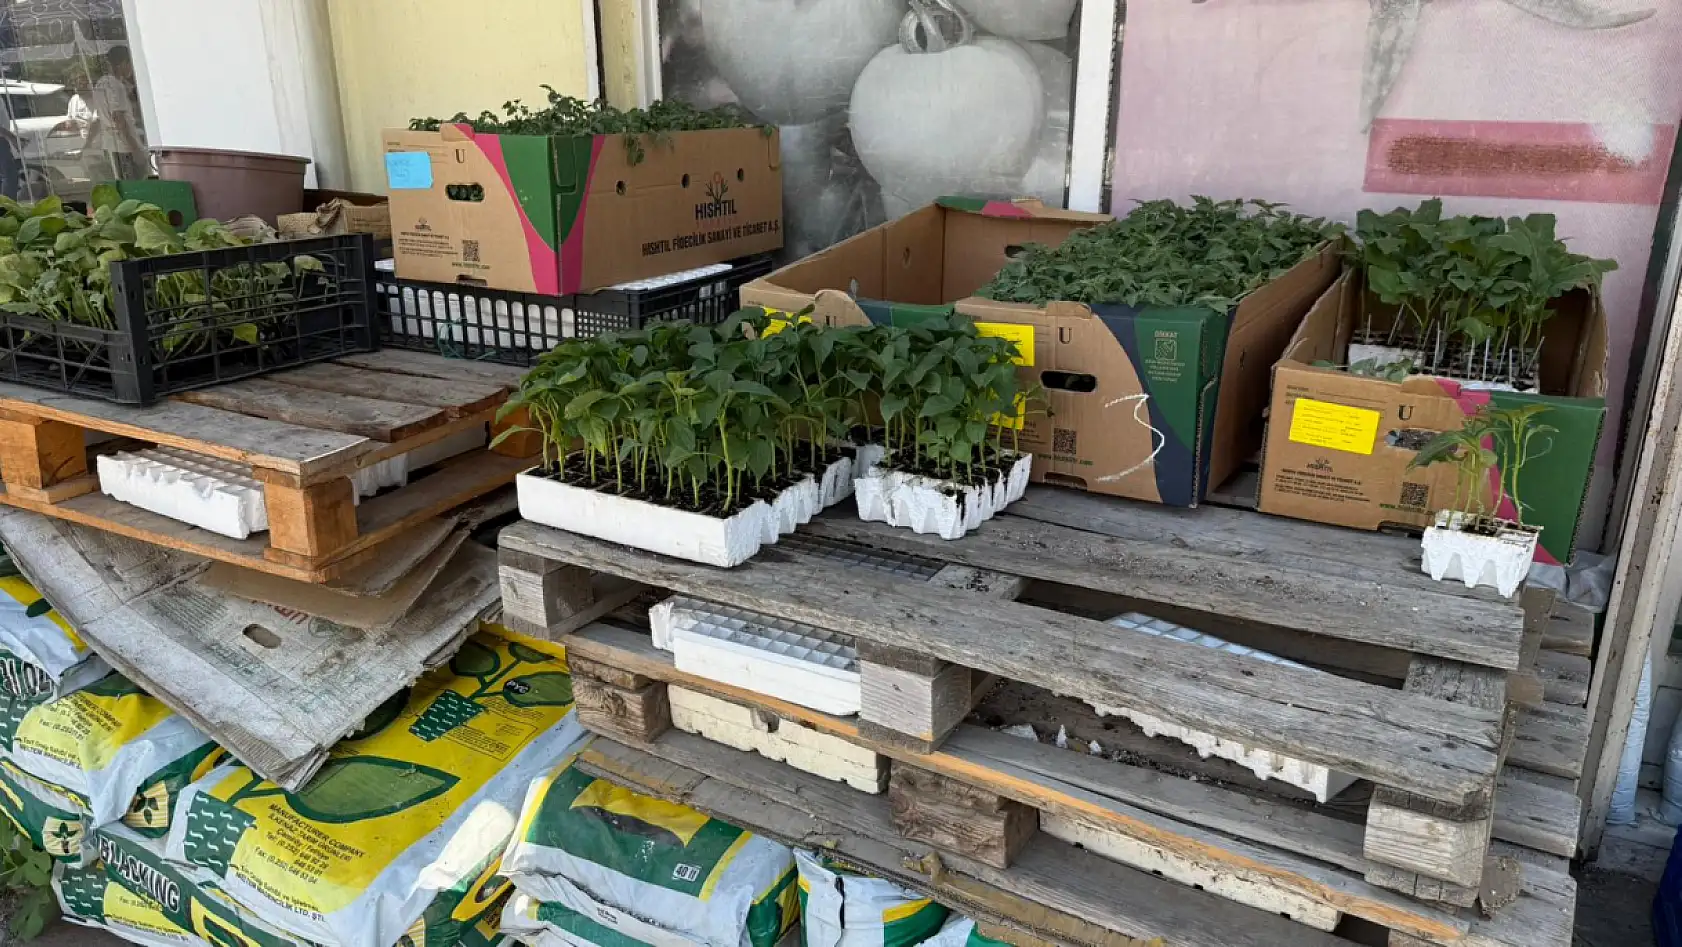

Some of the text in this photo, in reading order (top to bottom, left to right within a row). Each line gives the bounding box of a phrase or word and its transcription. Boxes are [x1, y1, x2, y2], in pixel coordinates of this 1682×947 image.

[695, 199, 737, 220] HISHTIL
[642, 239, 672, 257] HISHTIL
[1059, 327, 1072, 344] U
[1398, 404, 1414, 421] U
[267, 803, 331, 842] MANUFACTURER
